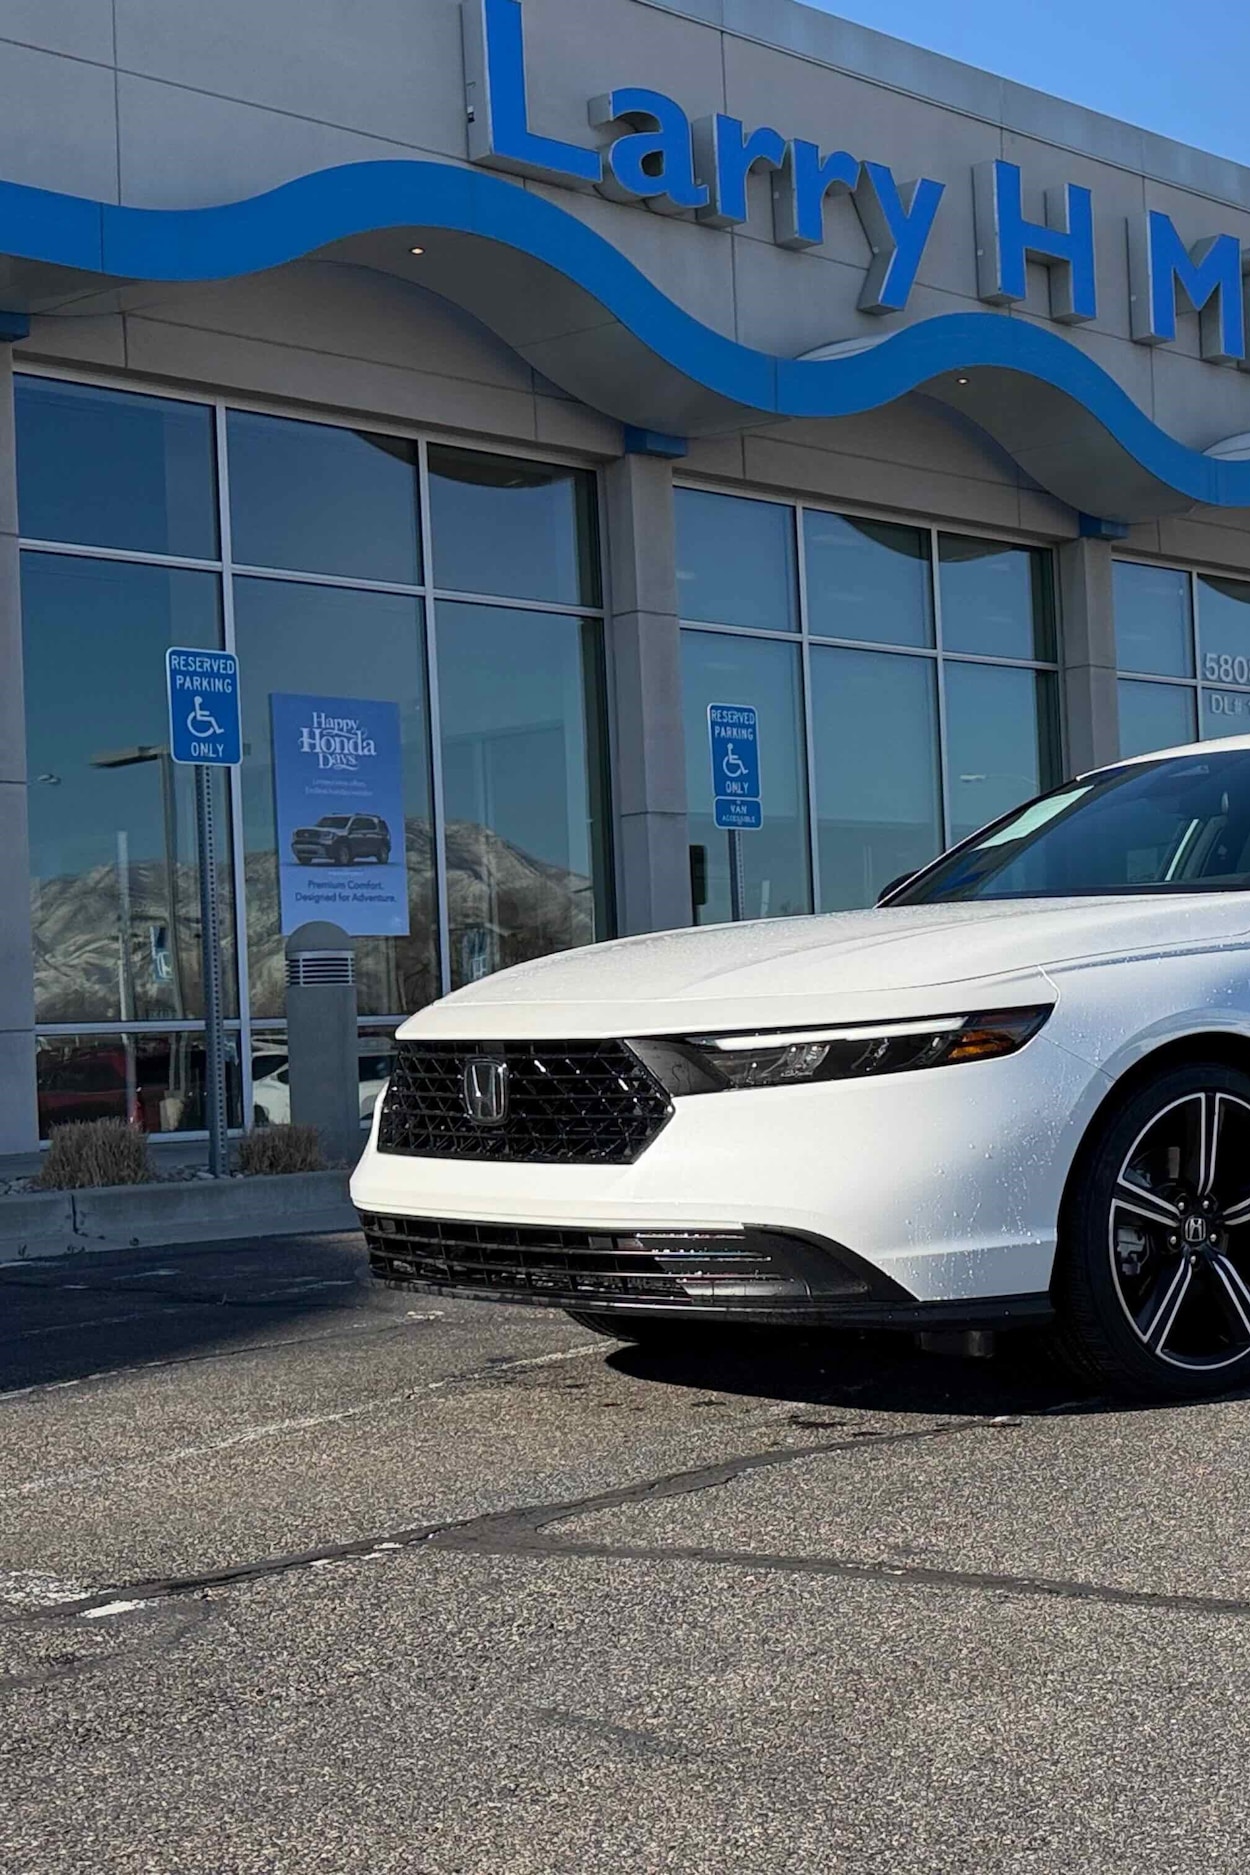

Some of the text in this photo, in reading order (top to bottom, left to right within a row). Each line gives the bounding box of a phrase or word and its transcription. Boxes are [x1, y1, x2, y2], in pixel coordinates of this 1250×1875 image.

[470, 0, 945, 314] Larry
[982, 157, 1098, 324] H
[171, 655, 235, 674] RESERVED
[176, 675, 232, 693] PARKING
[1211, 694, 1242, 715] DL#
[312, 711, 359, 733] Happy
[711, 709, 755, 724] RESERVED
[714, 725, 753, 740] PARKING
[298, 727, 377, 755] Honda
[191, 742, 224, 757] ONLY
[318, 753, 359, 771] Days
[725, 781, 749, 794] ONLY
[730, 804, 747, 815] VAN
[307, 879, 345, 890] Premium
[295, 892, 336, 904] Designed
[338, 893, 350, 902] for
